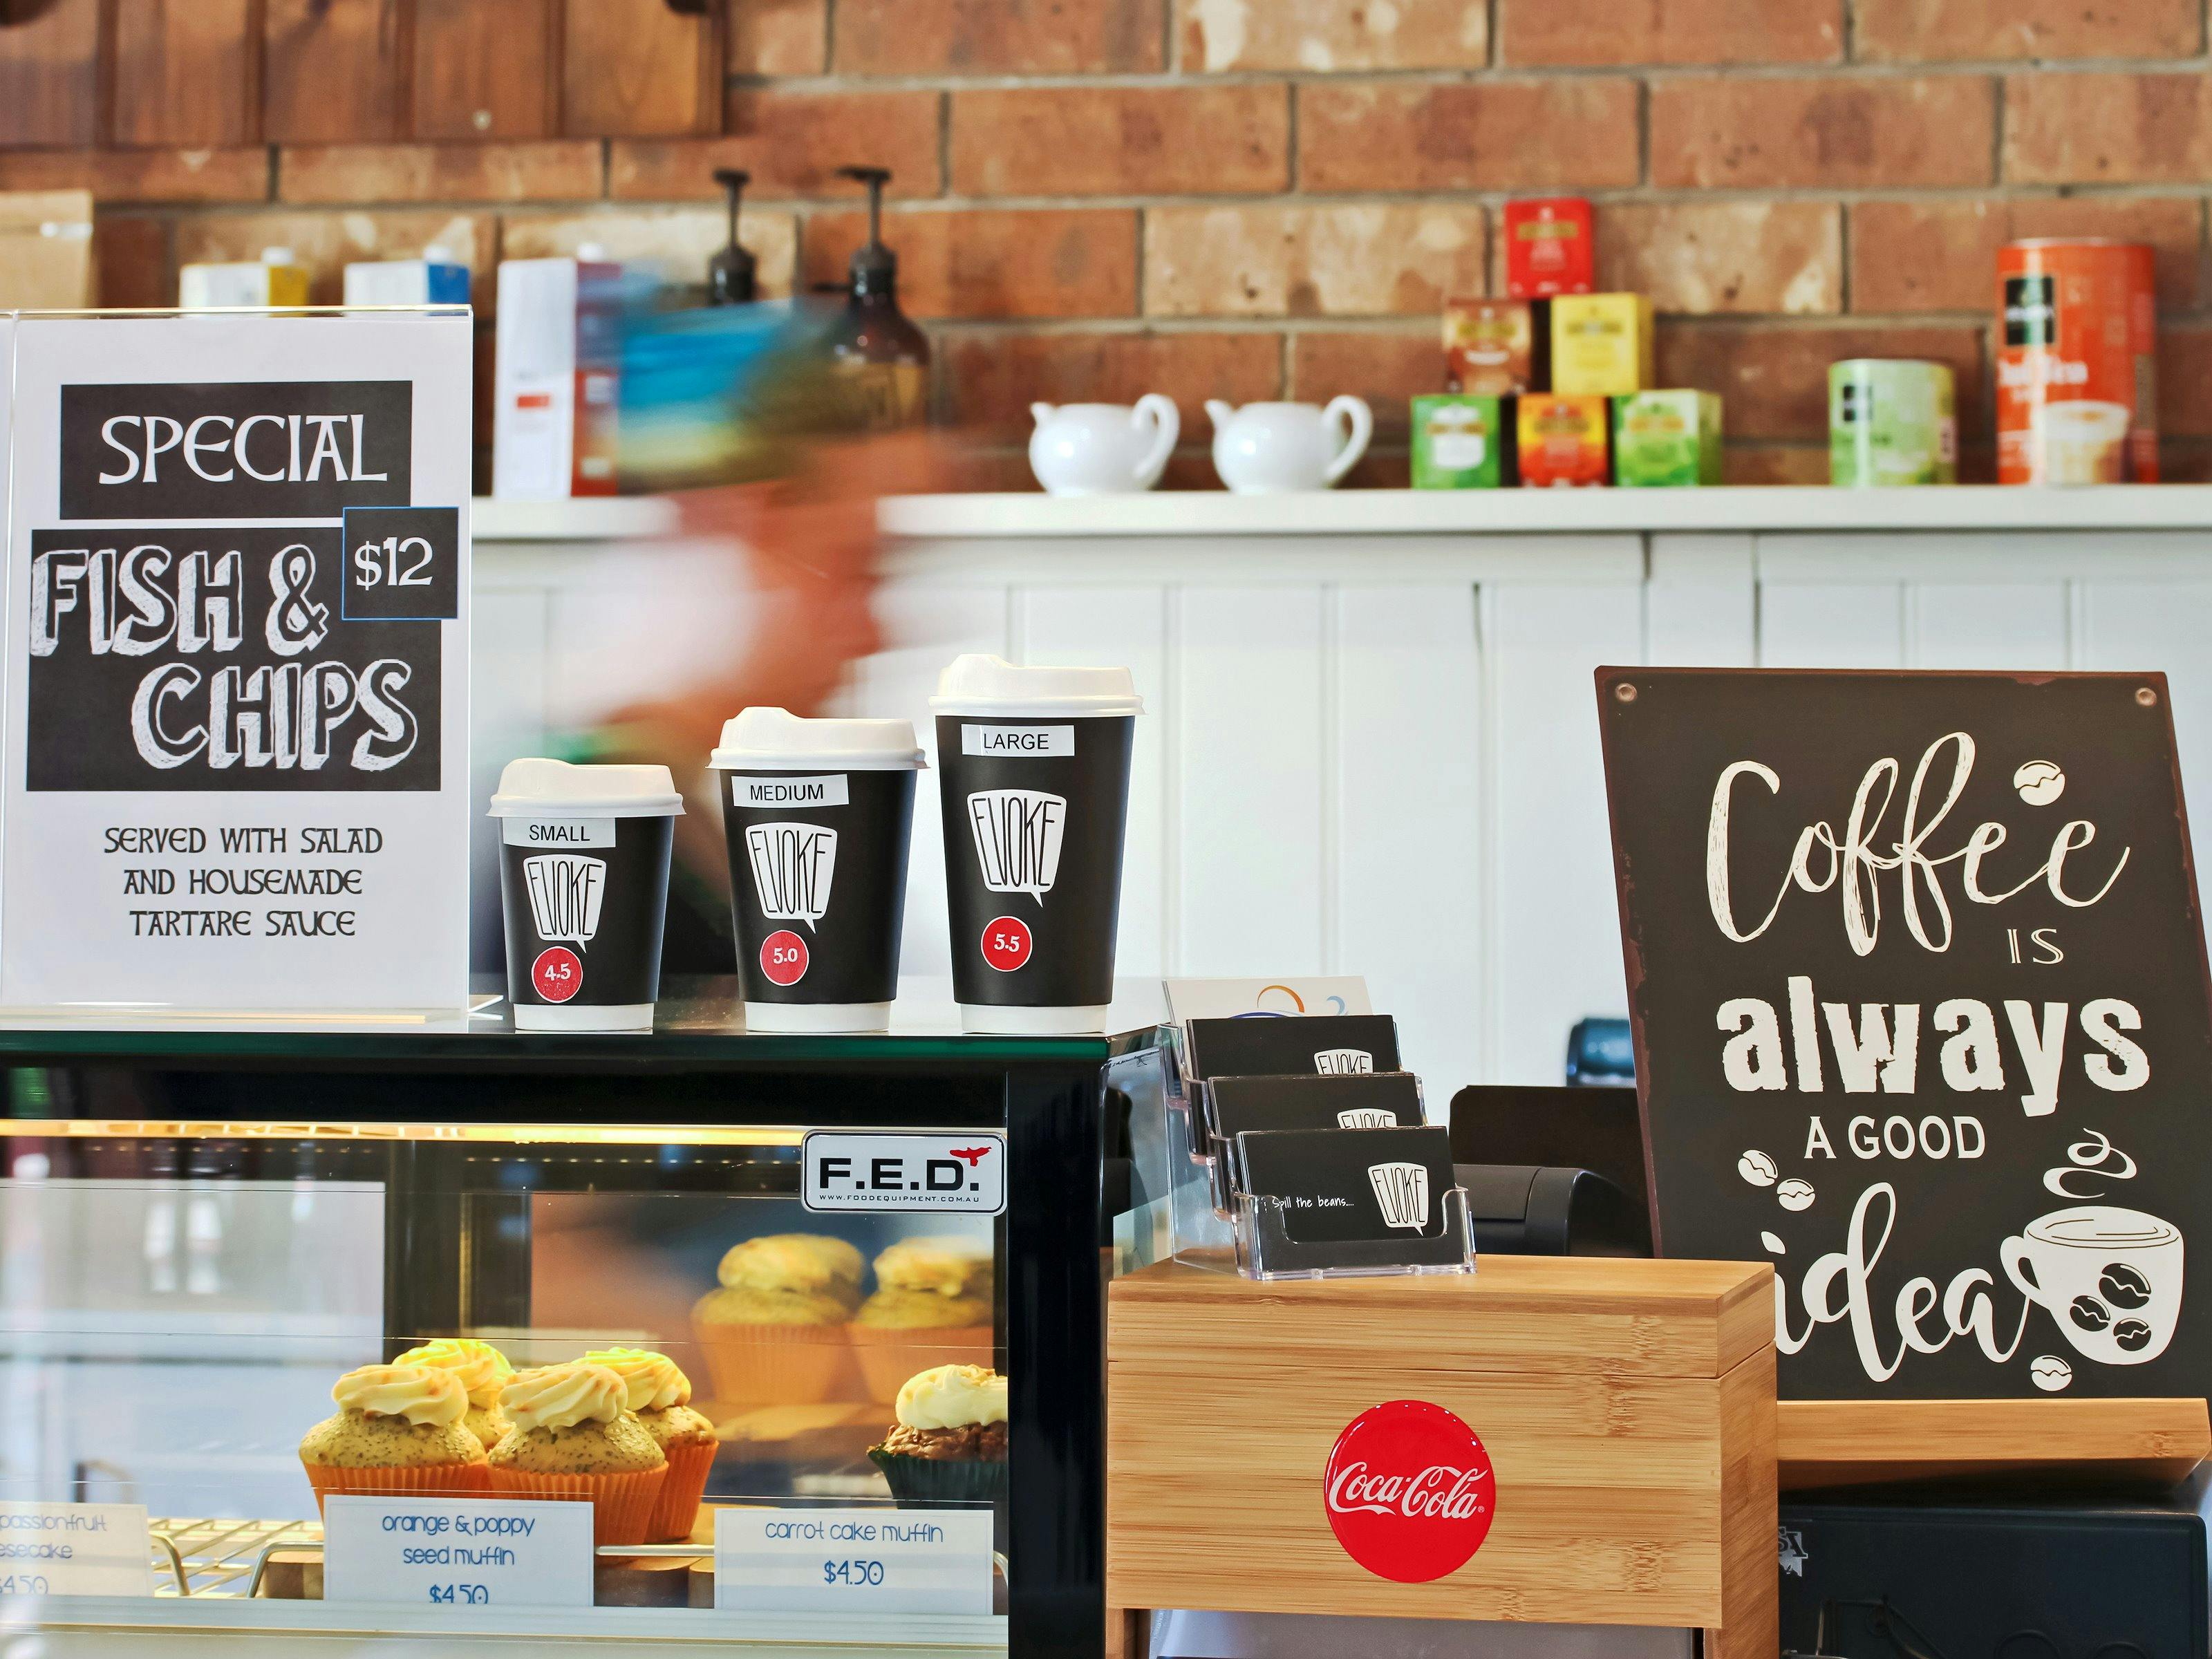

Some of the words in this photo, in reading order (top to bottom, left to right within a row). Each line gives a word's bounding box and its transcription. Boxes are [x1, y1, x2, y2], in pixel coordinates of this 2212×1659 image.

[99, 414, 388, 485] SPECIAL
[354, 536, 433, 591] $12
[30, 545, 243, 657] FISH
[265, 544, 329, 657] &
[131, 659, 418, 772] CHIPS
[984, 733, 1049, 750] LARGE
[750, 783, 824, 801] MEDIUM
[104, 827, 207, 854] SERVED
[220, 827, 286, 853] WITH
[300, 827, 383, 854] SALAD
[529, 824, 590, 842] SMALL
[972, 796, 1062, 888] EVOKE
[1706, 731, 2130, 957] Coffee
[123, 868, 176, 895] AND
[189, 869, 362, 895] HOUSEMADE
[749, 830, 832, 915] EVOKE
[527, 860, 602, 937] EVOKE
[129, 910, 252, 937] TARTARE
[265, 910, 355, 937] SAUCE
[773, 947, 798, 964] 5.0
[993, 933, 1020, 953] 5.5
[2007, 928, 2064, 964] IS
[544, 962, 571, 982] 4.5
[1716, 975, 2150, 1117] always
[1803, 1116, 1837, 1159] A
[1848, 1115, 1985, 1160] GOOD
[819, 1157, 980, 1191] F.E.D.
[819, 1194, 980, 1203] WWW.FOODEQUIPMENT.COM.AU
[1295, 1197, 1313, 1208] the
[1371, 1168, 1425, 1224] EVOKE
[1761, 1181, 2030, 1382] idea
[382, 1515, 450, 1536] orange
[455, 1515, 473, 1537] &
[474, 1517, 536, 1537] poppy
[765, 1521, 825, 1540] carrot
[830, 1521, 877, 1541] cake
[882, 1523, 944, 1543] muffin
[403, 1546, 450, 1564] seed
[454, 1546, 515, 1566] muffin
[824, 1559, 884, 1586] $4.50
